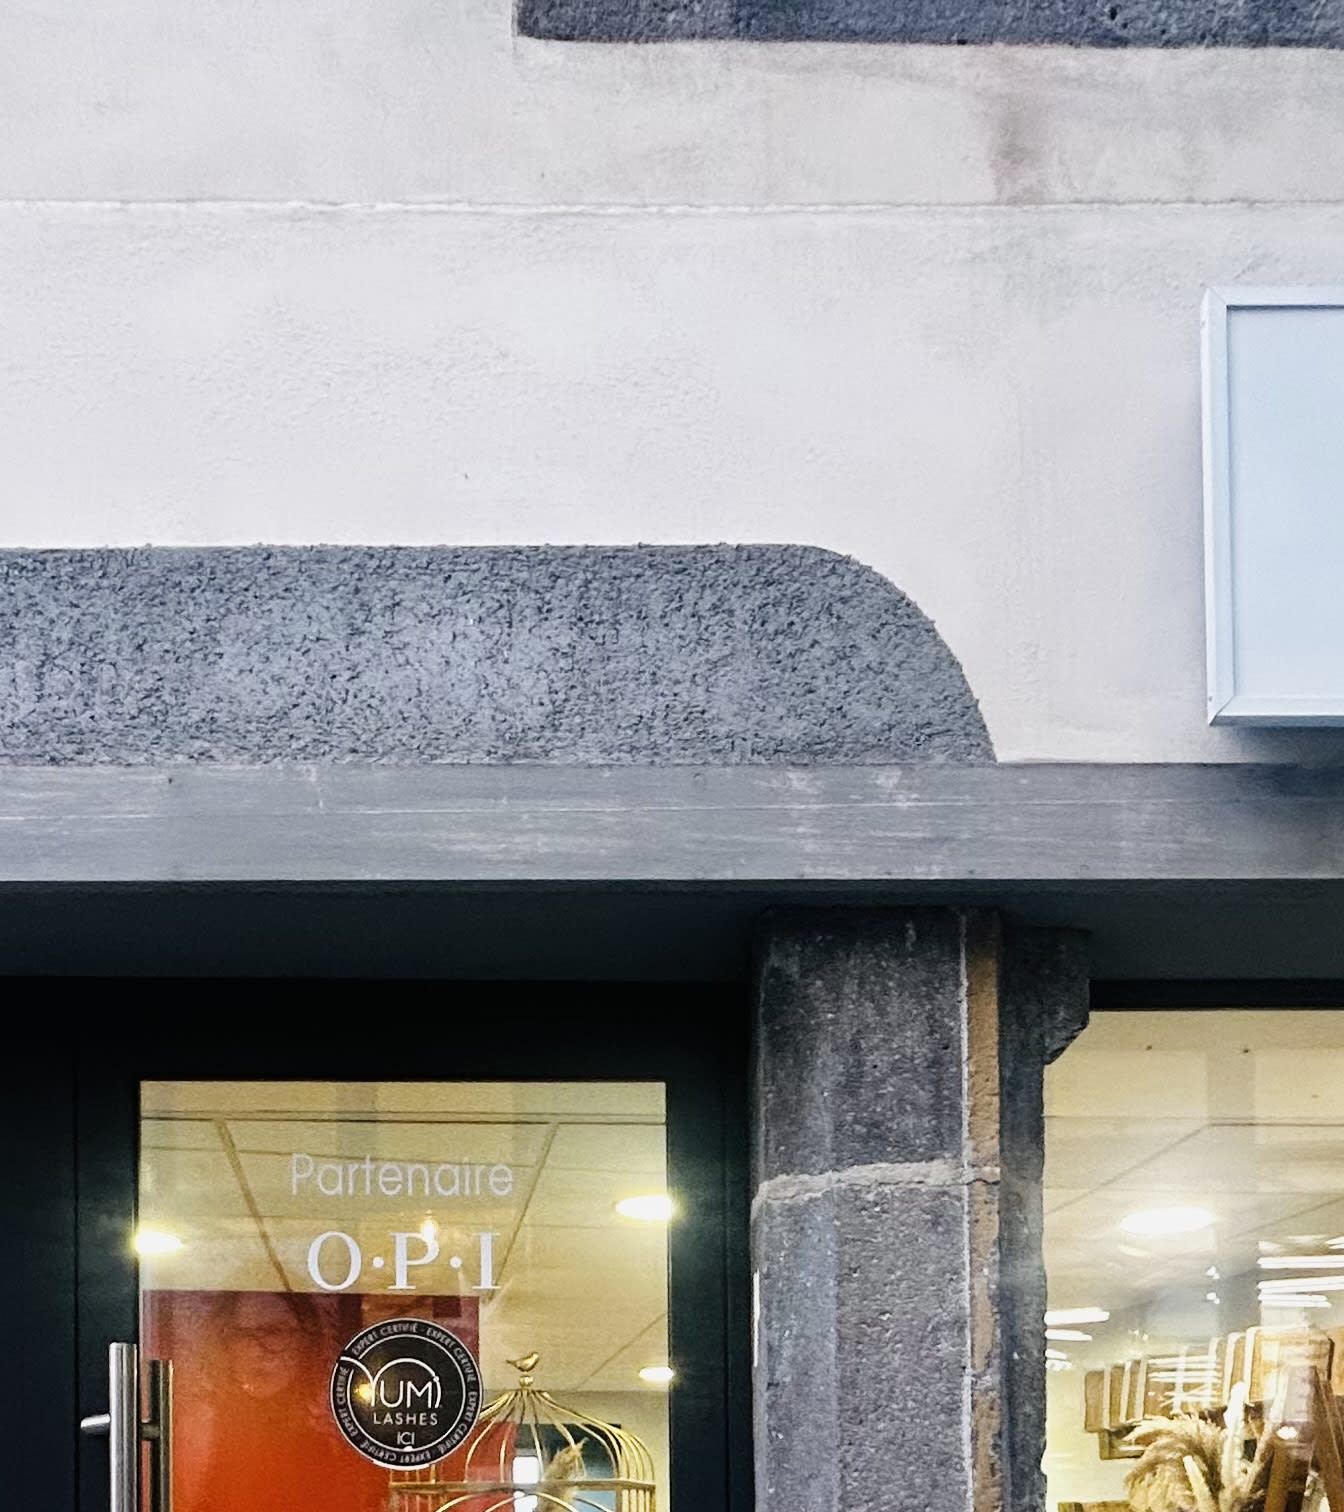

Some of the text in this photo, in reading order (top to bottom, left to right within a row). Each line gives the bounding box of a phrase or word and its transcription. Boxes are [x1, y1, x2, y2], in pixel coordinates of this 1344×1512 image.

[291, 1153, 513, 1196] Partenaire
[373, 1412, 438, 1426] LASHES
[397, 1431, 415, 1445] ICI
